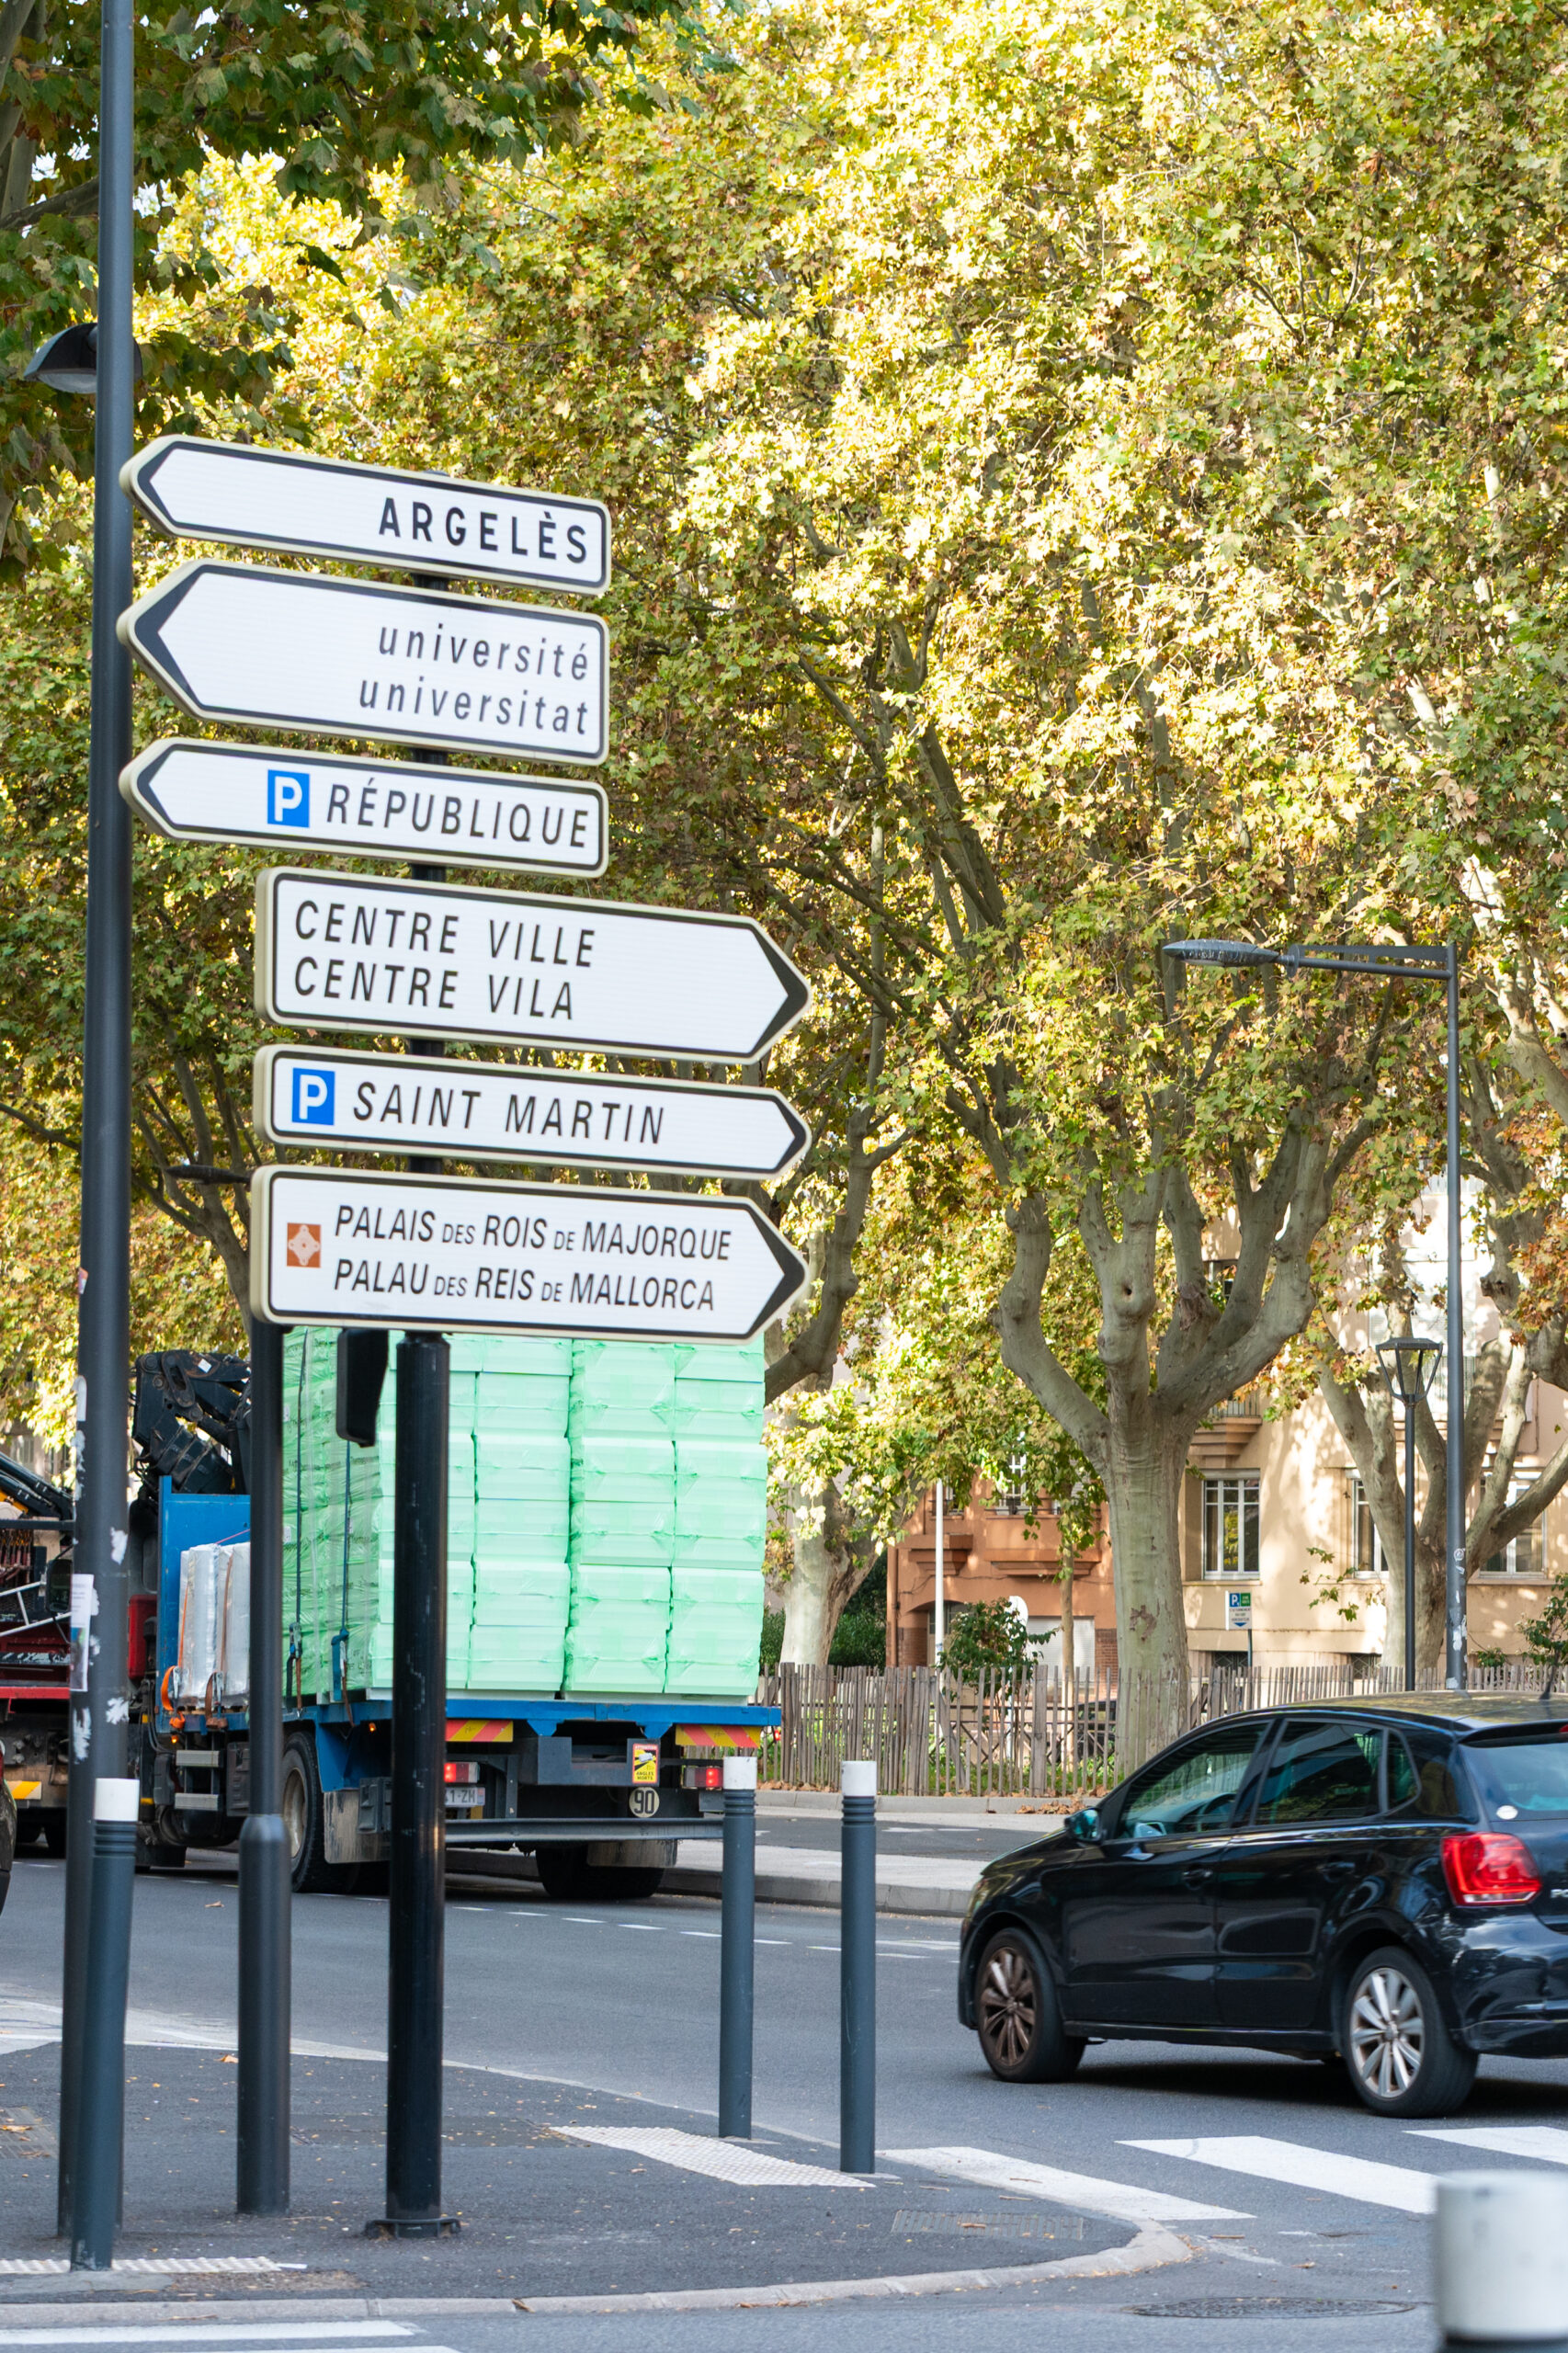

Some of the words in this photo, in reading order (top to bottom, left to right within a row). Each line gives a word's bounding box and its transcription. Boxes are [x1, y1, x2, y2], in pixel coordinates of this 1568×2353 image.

[379, 497, 586, 564] ARGELÈS
[379, 622, 587, 680] université
[359, 680, 587, 735] universitat
[274, 776, 303, 823] P
[326, 778, 588, 848] RÉPUBLIQUE
[295, 900, 459, 954] CENTRE
[489, 919, 595, 968] VILLE
[294, 956, 459, 1009] CENTRE
[488, 974, 572, 1020] VILA
[299, 1074, 328, 1120] P
[353, 1081, 482, 1129] SAINT
[505, 1094, 664, 1144] MARTIN
[335, 1205, 436, 1243] PALAIS
[442, 1223, 475, 1245] DES
[483, 1214, 548, 1249] ROIS
[554, 1230, 575, 1251] DE
[582, 1221, 732, 1260] MAJORQUE
[334, 1258, 428, 1295] PALAU
[434, 1276, 468, 1297] DES
[474, 1267, 535, 1301] REIS
[540, 1281, 562, 1302] DE
[570, 1272, 713, 1311] MALLORCA
[633, 1789, 655, 1814] 90
